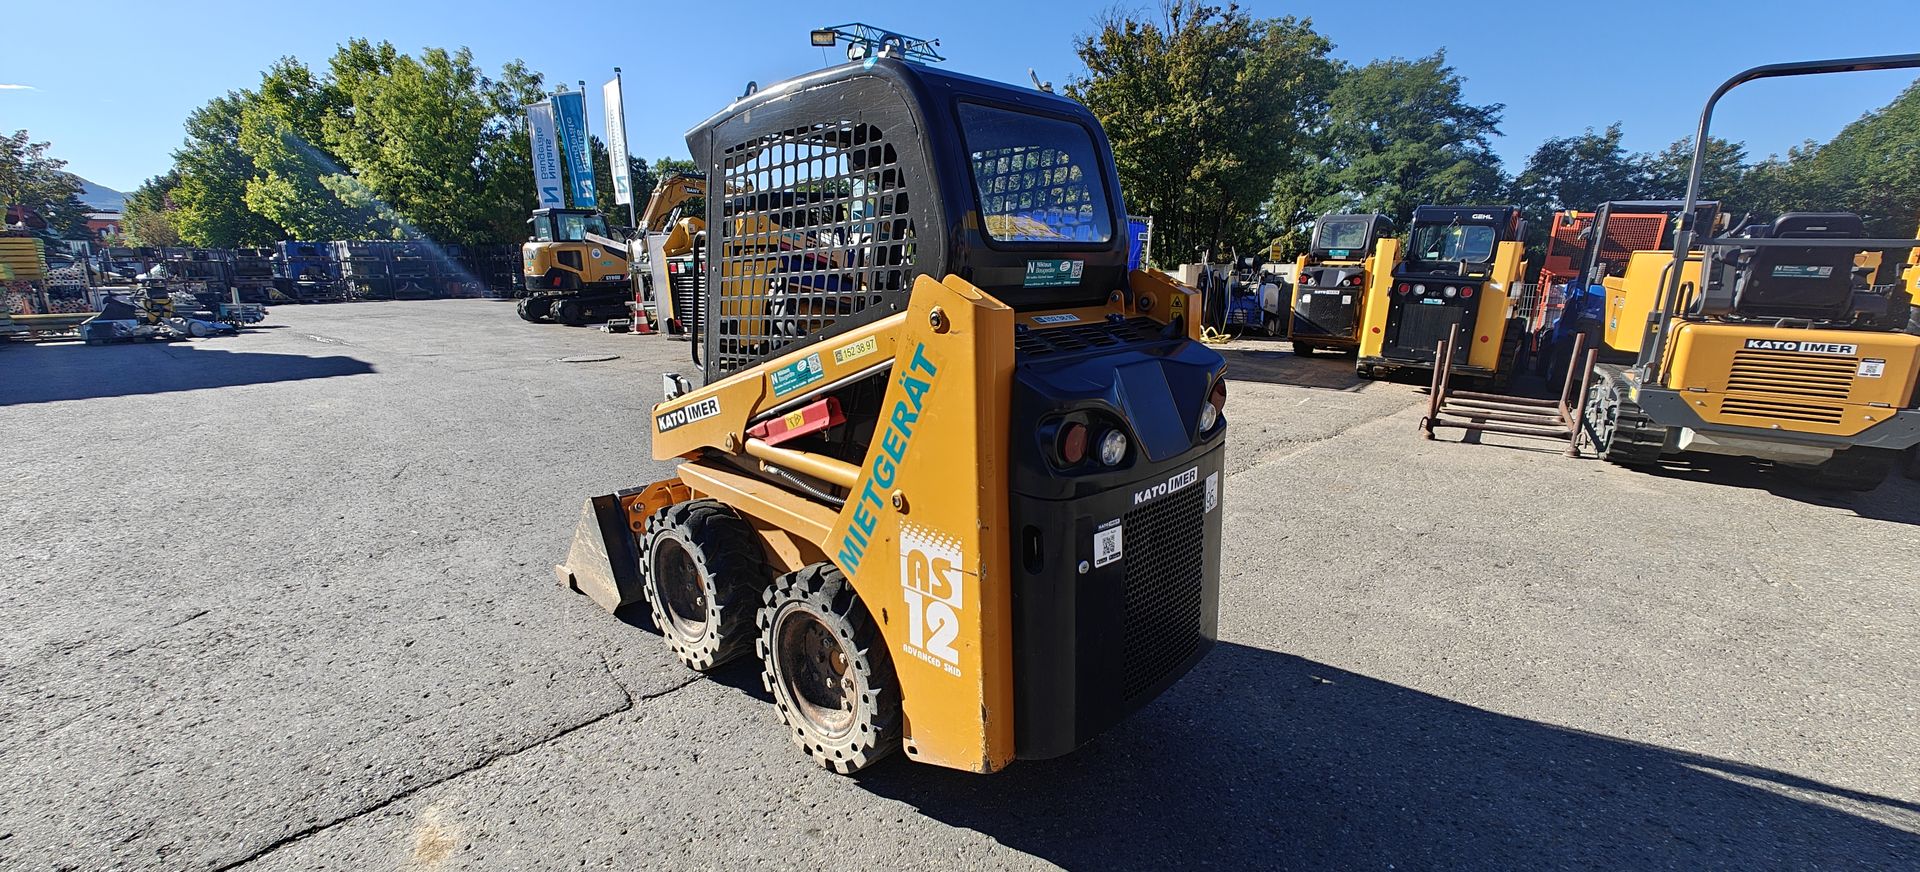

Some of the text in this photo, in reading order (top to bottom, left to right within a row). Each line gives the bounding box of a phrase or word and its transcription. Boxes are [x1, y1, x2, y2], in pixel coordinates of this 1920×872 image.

[843, 339, 875, 359] 152 38 97
[1748, 340, 1853, 354] KATO IMER
[658, 401, 718, 431] KATO IMER
[838, 342, 937, 575] MIETGERÄT
[1134, 470, 1195, 504] KATO IMER
[907, 549, 953, 600] AS
[904, 588, 959, 665] 12
[903, 643, 962, 677] ADVANCED SKID
